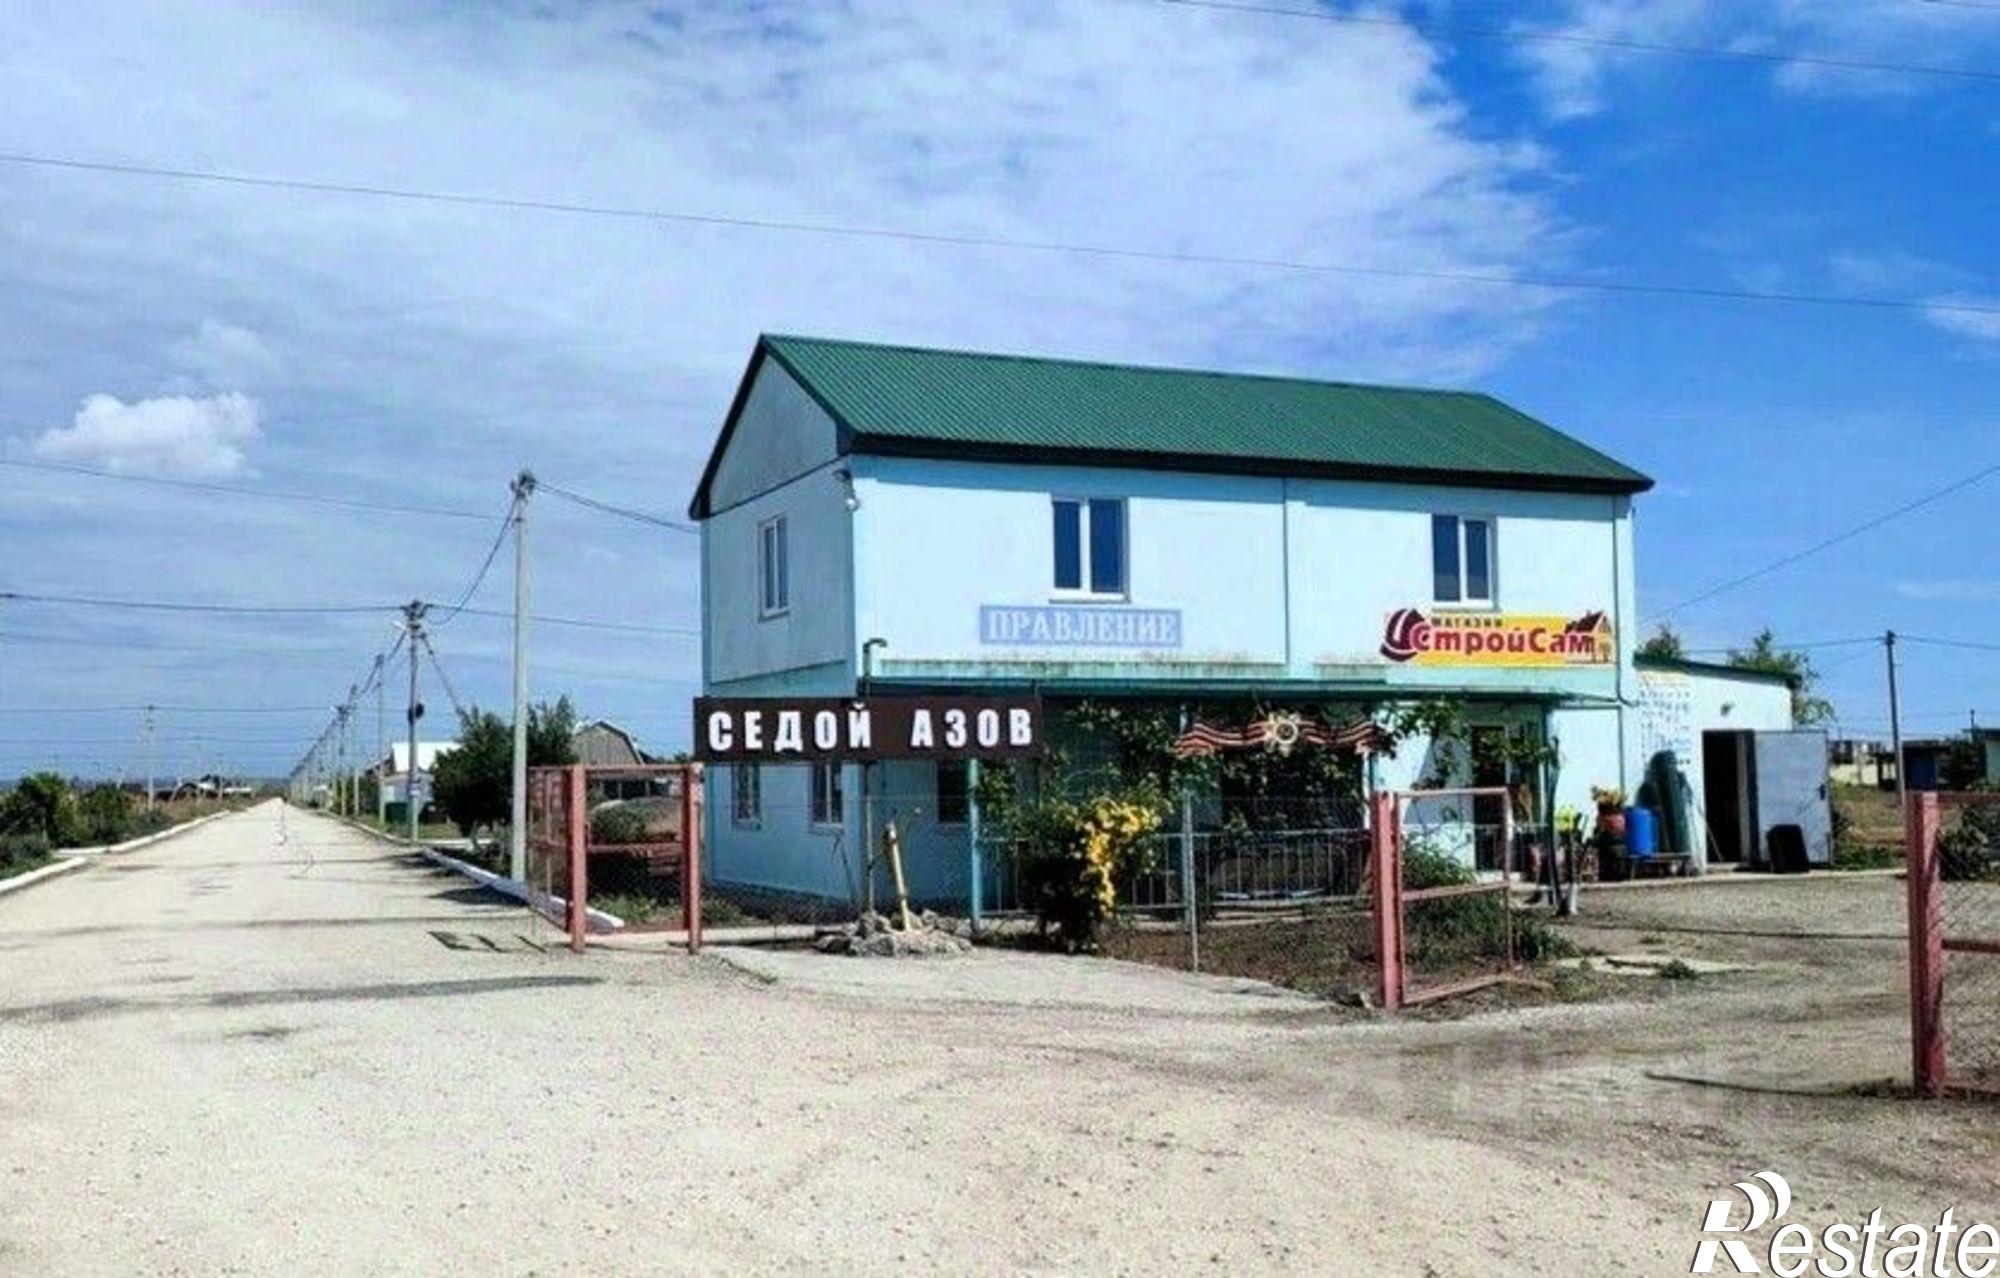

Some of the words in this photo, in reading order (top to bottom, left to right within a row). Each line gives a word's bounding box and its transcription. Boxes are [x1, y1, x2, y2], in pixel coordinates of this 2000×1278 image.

[989, 609, 1176, 642] ПРАВЛЕНИЕ
[708, 703, 871, 752] СЕДОЙ
[911, 709, 1033, 748] АЗОВ
